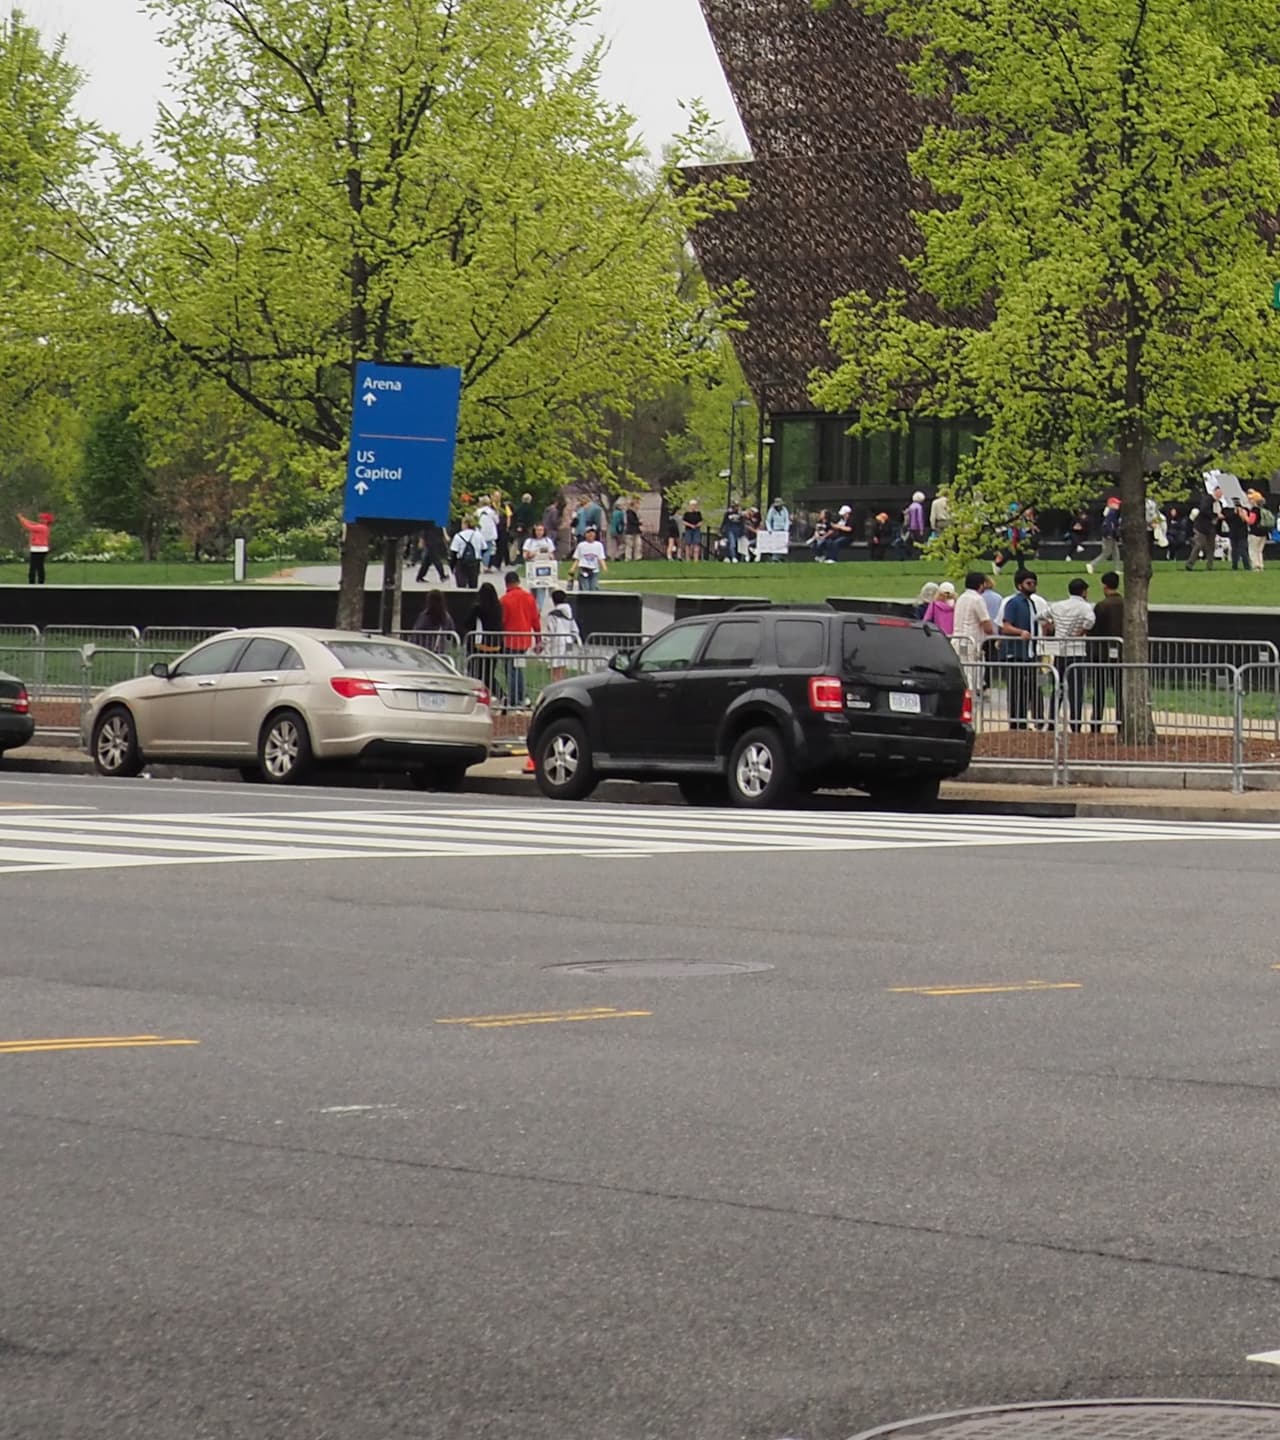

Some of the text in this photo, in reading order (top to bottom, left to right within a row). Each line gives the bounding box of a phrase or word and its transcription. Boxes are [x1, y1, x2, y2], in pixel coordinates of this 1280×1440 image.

[363, 376, 402, 391] Arena
[356, 450, 375, 463] US
[355, 466, 402, 481] Capitol
